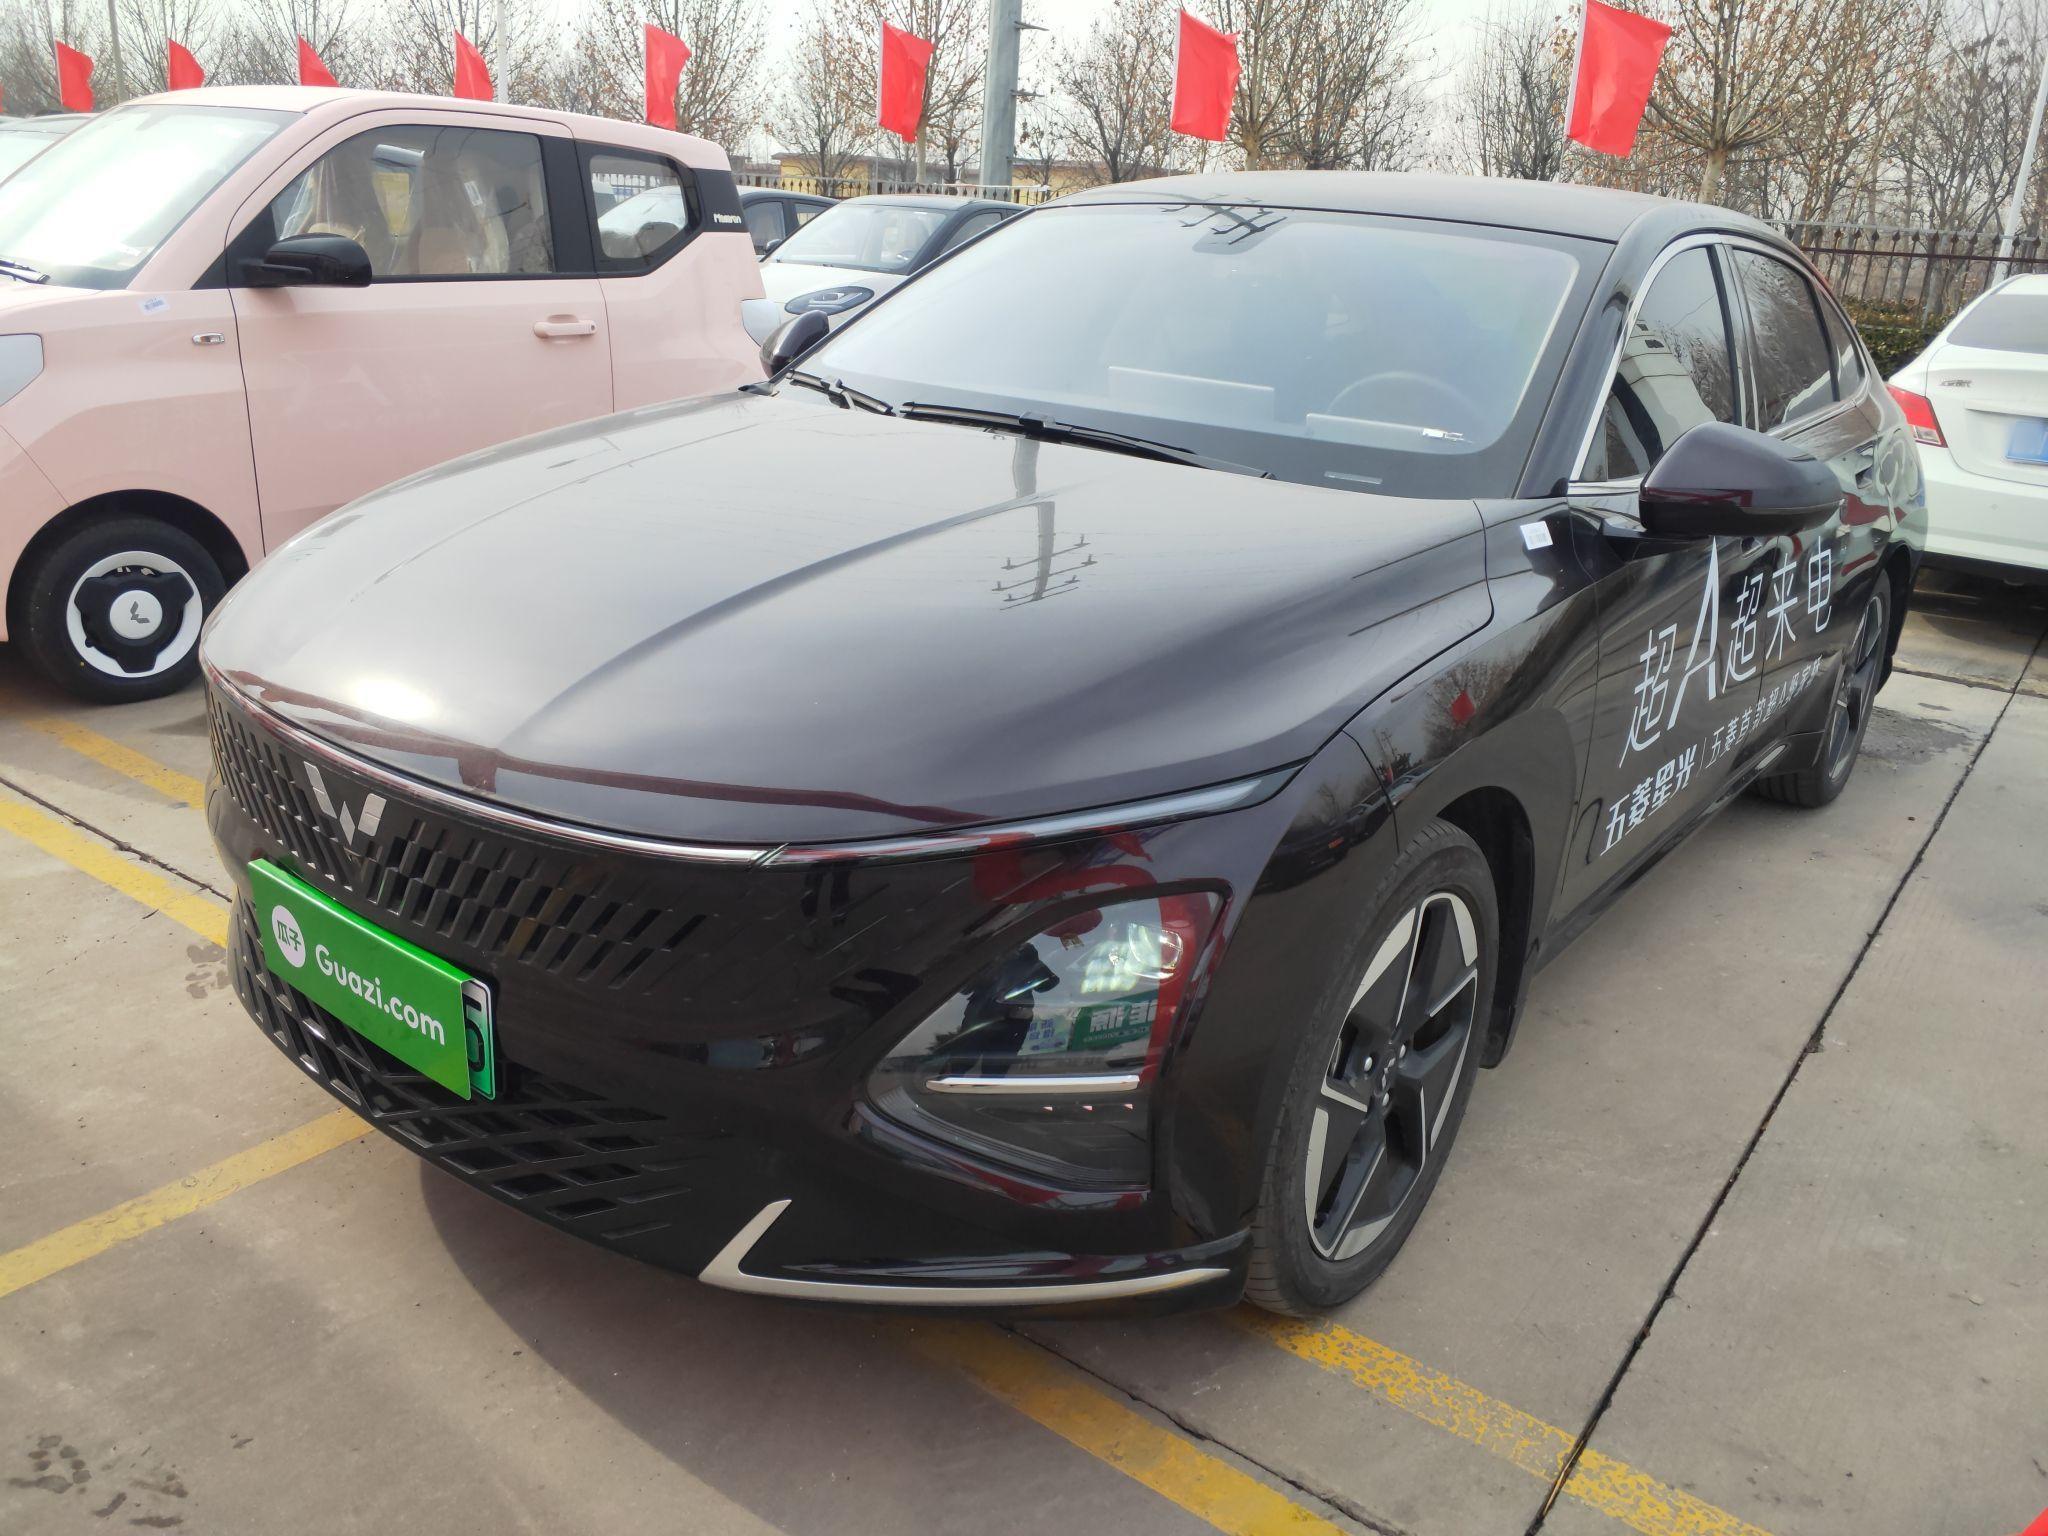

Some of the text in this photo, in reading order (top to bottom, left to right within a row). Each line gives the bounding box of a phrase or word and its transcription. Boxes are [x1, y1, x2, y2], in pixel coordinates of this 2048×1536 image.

[1619, 536, 1832, 768] 超A超来电
[1600, 744, 1698, 857] 五菱星光
[277, 919, 302, 952] 瓜子
[315, 944, 446, 1046] Guazi.com
